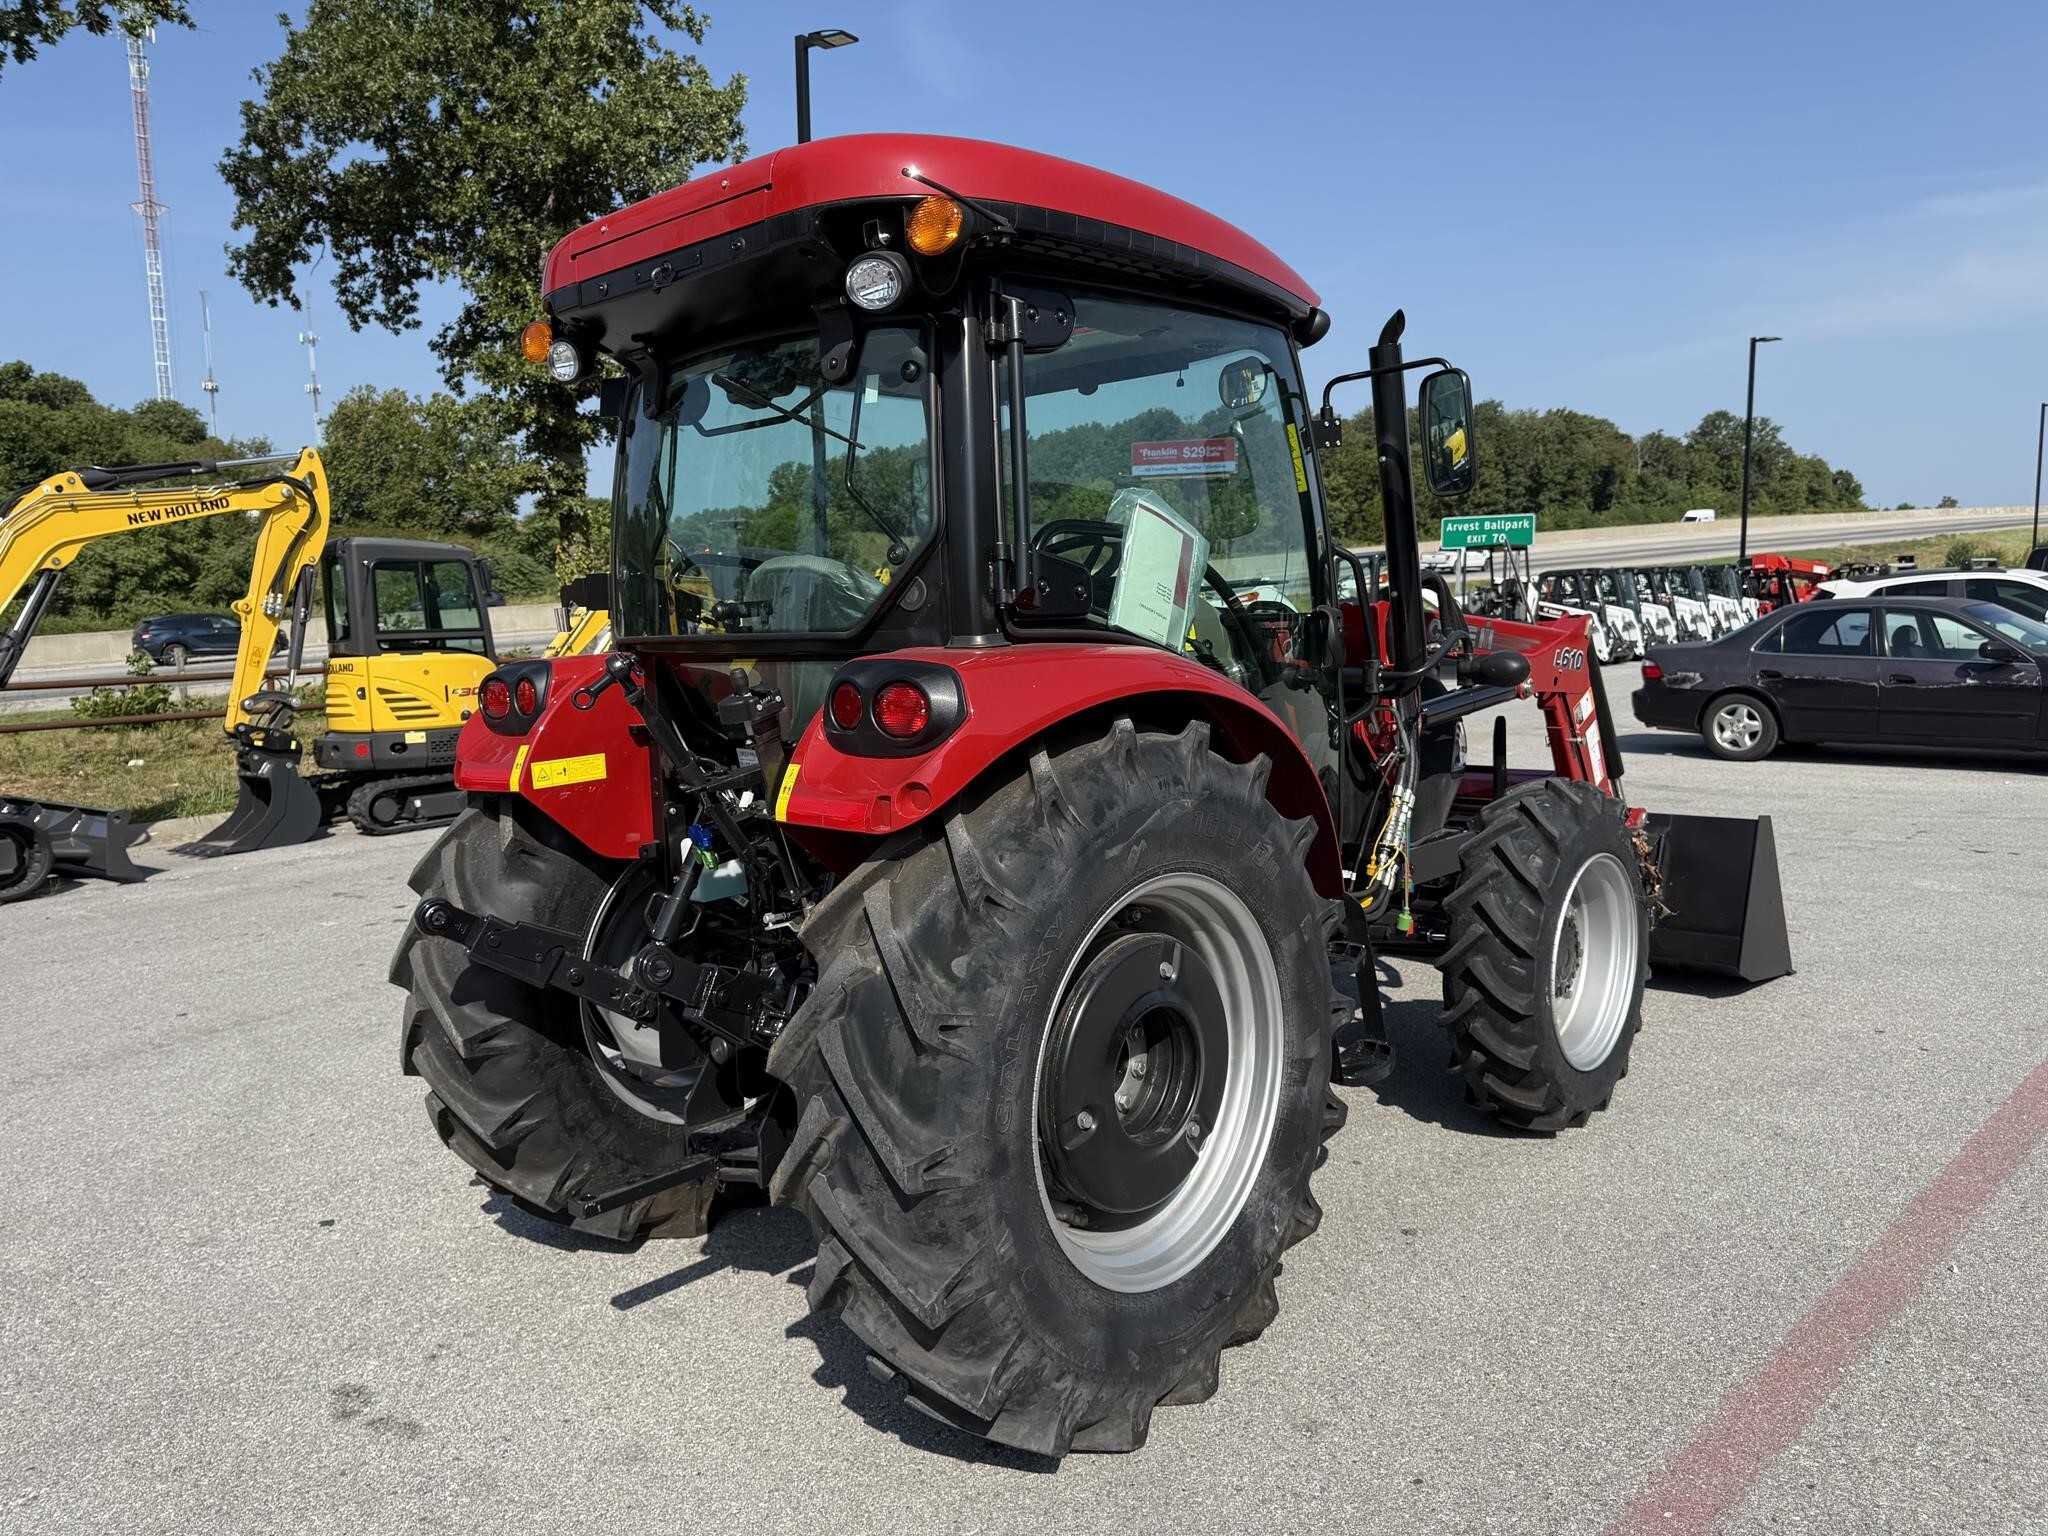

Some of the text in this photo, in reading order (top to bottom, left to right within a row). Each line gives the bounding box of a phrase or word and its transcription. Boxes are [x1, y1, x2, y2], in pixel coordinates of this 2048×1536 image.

[1142, 448, 1177, 457] Franklin
[1183, 446, 1206, 459] $29
[127, 497, 230, 525] NEW HOLLAND
[1446, 519, 1529, 532] Arvest Ballpark
[1466, 533, 1506, 544] EXIT 70
[1553, 646, 1584, 672] L610
